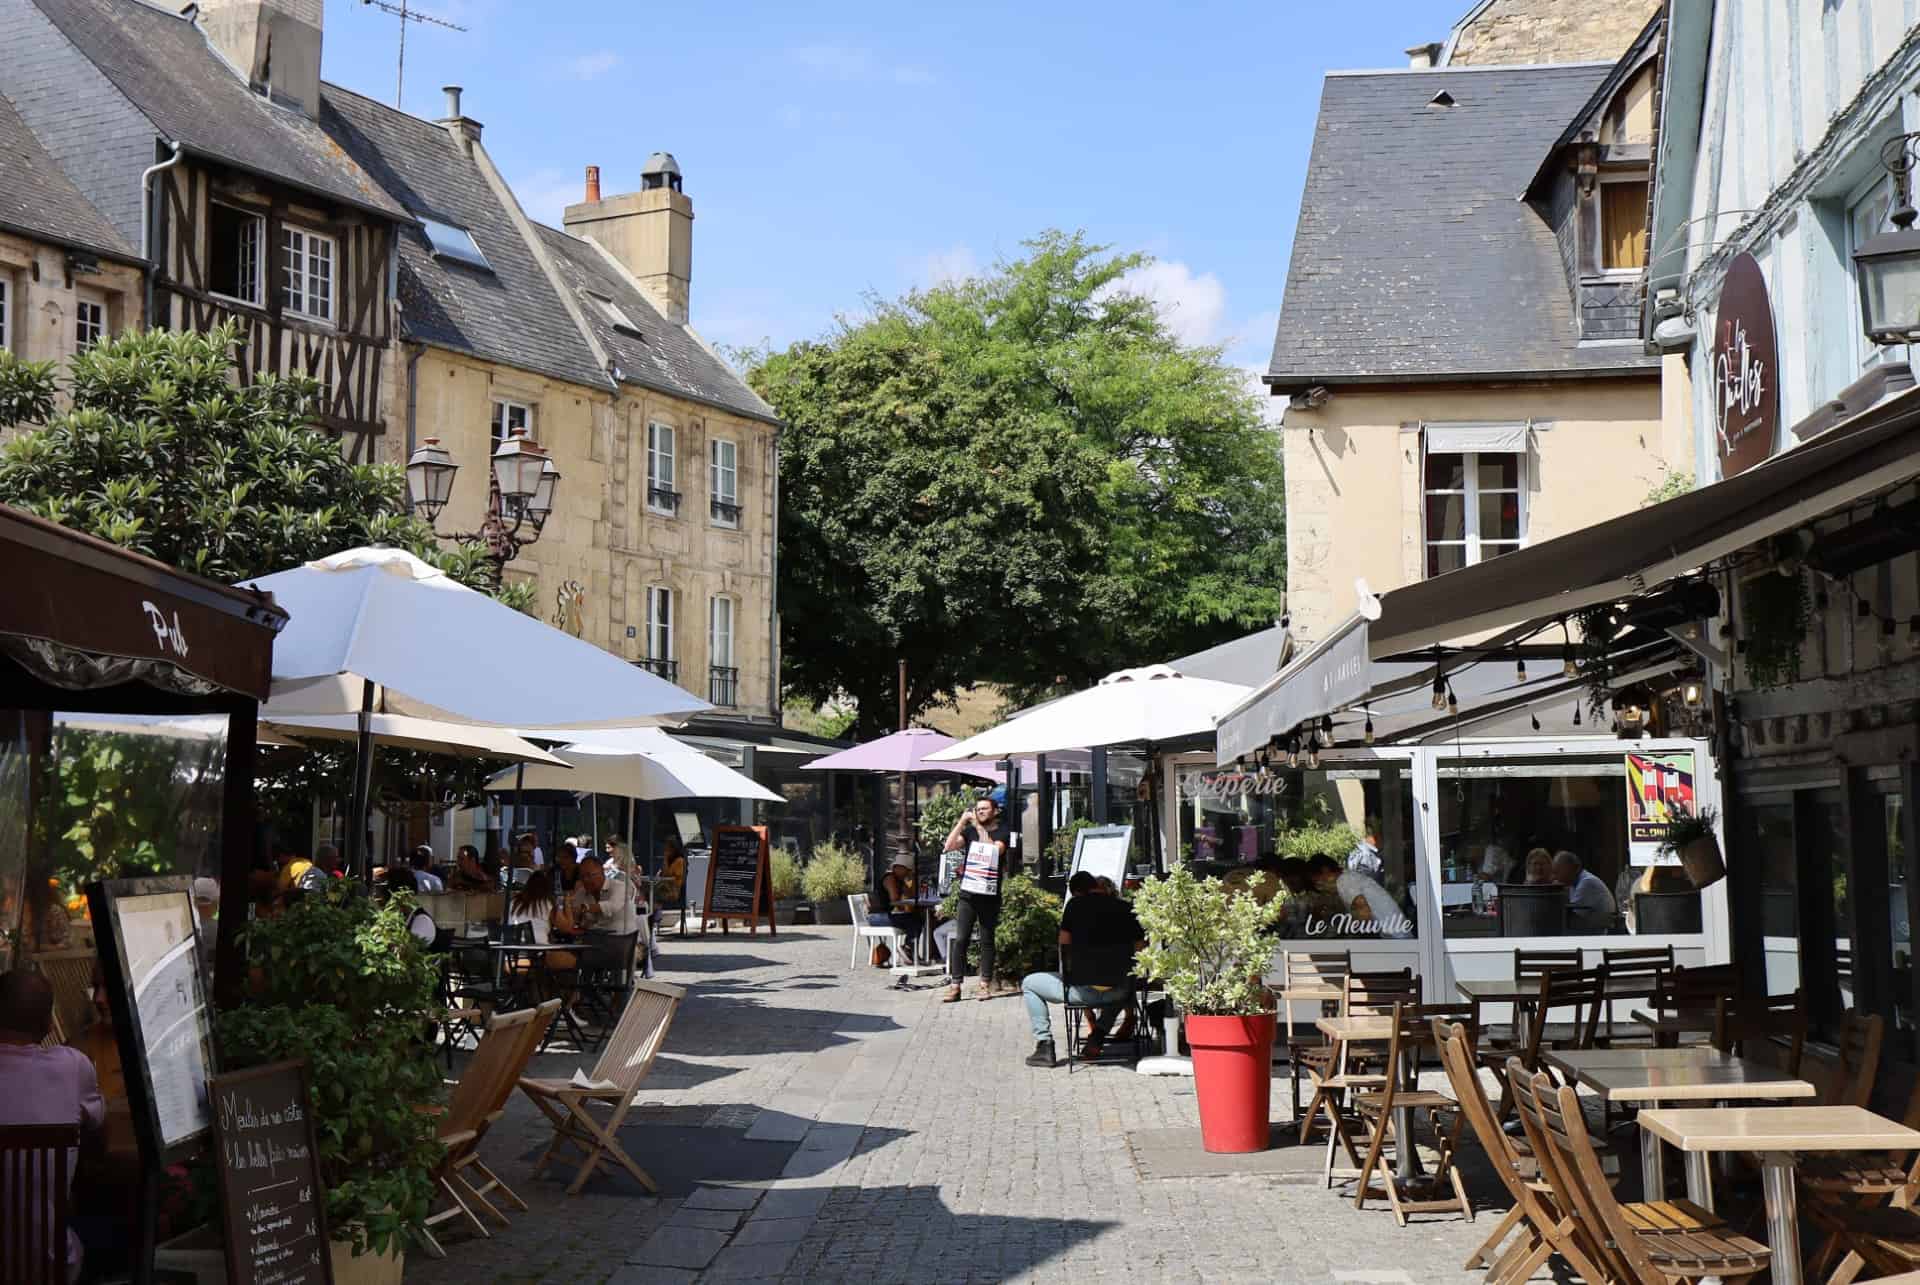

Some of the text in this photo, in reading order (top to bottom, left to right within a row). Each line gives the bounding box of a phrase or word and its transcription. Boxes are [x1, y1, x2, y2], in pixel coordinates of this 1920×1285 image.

[142, 600, 189, 658] Pub
[1182, 771, 1288, 804] Crêperie
[1305, 913, 1414, 936] Le Neuville
